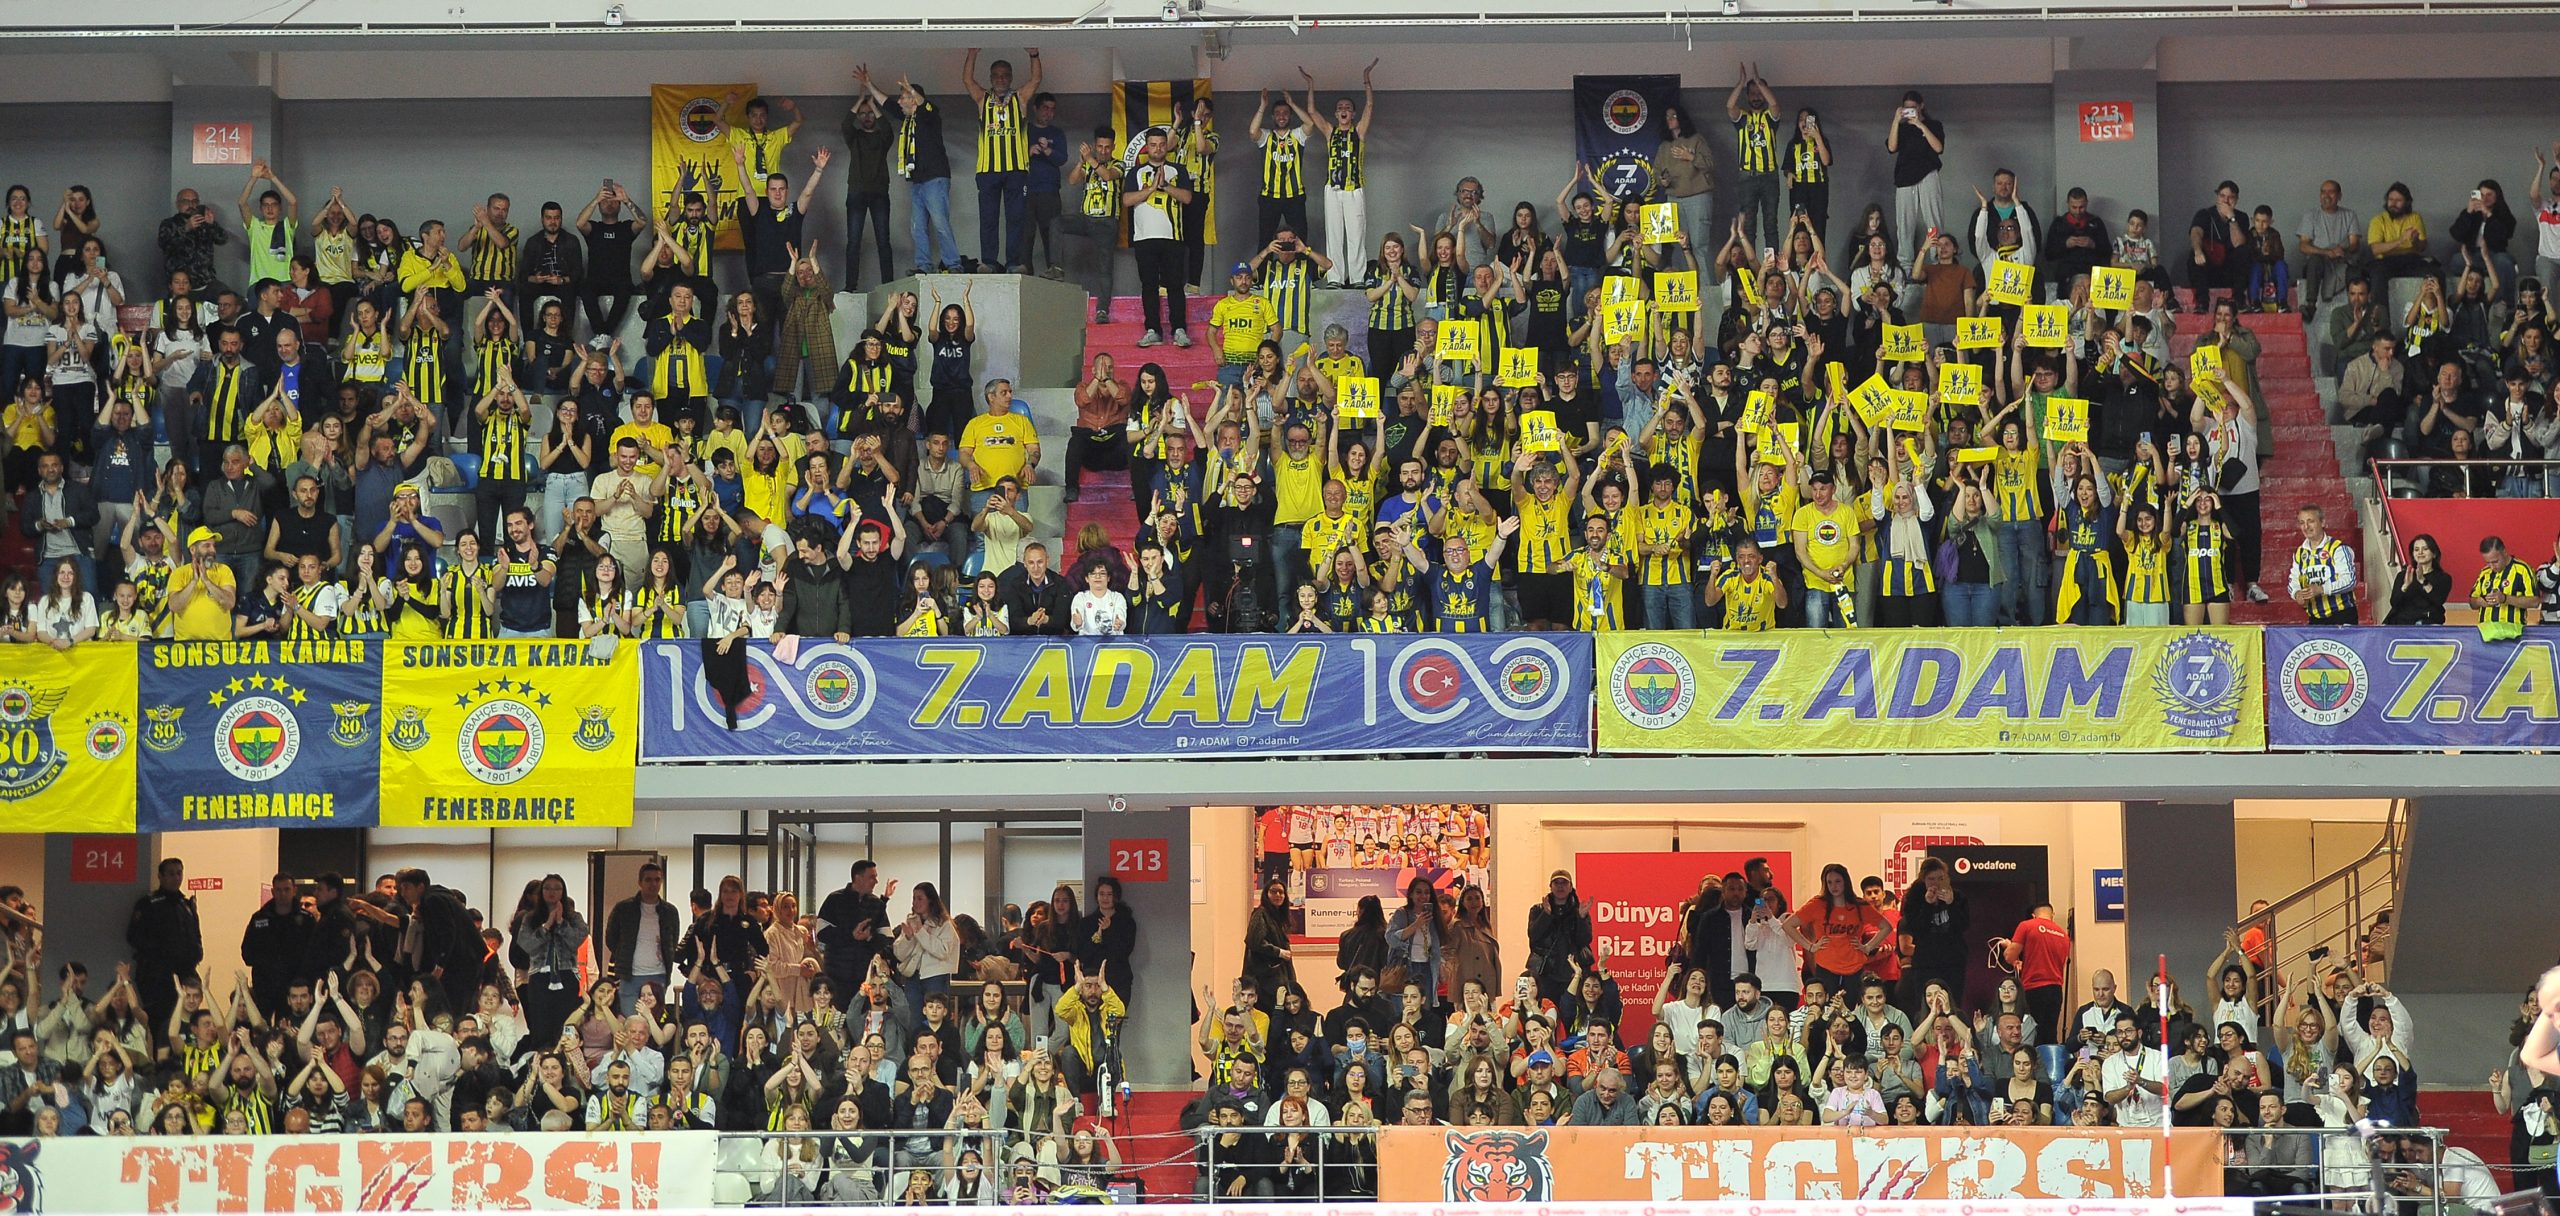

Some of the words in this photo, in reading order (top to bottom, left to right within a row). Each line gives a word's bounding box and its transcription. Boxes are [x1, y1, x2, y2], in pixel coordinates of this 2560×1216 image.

[205, 127, 241, 143] 214
[2090, 122, 2122, 138] ÜST
[207, 146, 240, 161] ÜST
[1270, 279, 1296, 289] AVIS
[1994, 283, 2000, 292] 7.
[2001, 286, 2024, 296] ADAM
[1668, 294, 1691, 303] ADAM
[2096, 291, 2103, 299] 7.
[2104, 291, 2126, 301] ADAM
[1229, 318, 1252, 328] HDI
[1971, 333, 1994, 341] ADAM
[2030, 329, 2036, 337] 7.
[2037, 329, 2060, 337] ADAM
[1442, 343, 1448, 351] 7.
[1449, 342, 1472, 351] ADAM
[1896, 345, 1917, 353] ADAM
[1512, 370, 1530, 379] ADAM
[1944, 385, 1951, 394] 7.
[1951, 385, 1975, 395] ADAM
[1343, 400, 1350, 408] 7.
[1350, 399, 1374, 408] ADAM
[1866, 408, 1874, 418] 7.
[1873, 395, 1892, 414] ADAM
[1895, 412, 1918, 422] ADAM
[2051, 422, 2057, 430] 7.
[2058, 423, 2080, 432] ADAM
[1523, 437, 1529, 445] 7.
[1531, 435, 1551, 443] ADAM
[506, 575, 537, 587] AVIS
[154, 641, 270, 668] SONSUZA
[280, 640, 366, 664] KADAR
[403, 645, 517, 667] SONSUZA
[527, 644, 612, 667] KADA
[1526, 656, 1544, 667] SPOR
[832, 663, 850, 675] SPOR
[2281, 643, 2318, 708] FENERBAHÇE
[2321, 641, 2353, 662] SPOR
[2350, 661, 2365, 708] KULÜBÜ
[1614, 646, 1649, 713] FENERBAHÇE
[1650, 646, 1682, 666] SPOR
[1680, 667, 1693, 713] KULÜBÜ
[2186, 673, 2215, 681] ADAM
[1002, 644, 1322, 727] ADAM
[1800, 645, 2135, 721] ADAM
[1641, 716, 1664, 726] 1907
[2313, 711, 2337, 723] 1907
[217, 700, 251, 764] FENERBAHÇE
[256, 699, 286, 719] SPOR
[284, 719, 299, 763] KULÜBÜ
[462, 703, 497, 766] FENERBAHÇE
[502, 703, 532, 721] SPOR
[530, 721, 544, 765] KULÜBÜ
[1189, 737, 1198, 746] 7.
[1200, 737, 1230, 746] ADAM
[1250, 735, 1300, 746] 7.adam.fb
[2020, 733, 2051, 742] ADAM
[2072, 733, 2121, 742] 7.adam.fb
[244, 769, 268, 779] 1907
[486, 771, 511, 783] 1907
[183, 793, 334, 821] FENERBAHÇE
[424, 797, 575, 823] FENERBAHÇE
[86, 851, 124, 869] 214
[1116, 850, 1162, 871] 213
[1972, 860, 2017, 871] vodafone
[1311, 909, 1357, 918] Runner-up
[1597, 902, 1673, 927] Dünya
[1598, 936, 1635, 956] Biz
[1639, 969, 1653, 979] Ligi
[1631, 984, 1655, 992] Kadın
[1624, 1137, 2152, 1200] TIGERS!
[121, 1140, 662, 1213] TIGERS!
